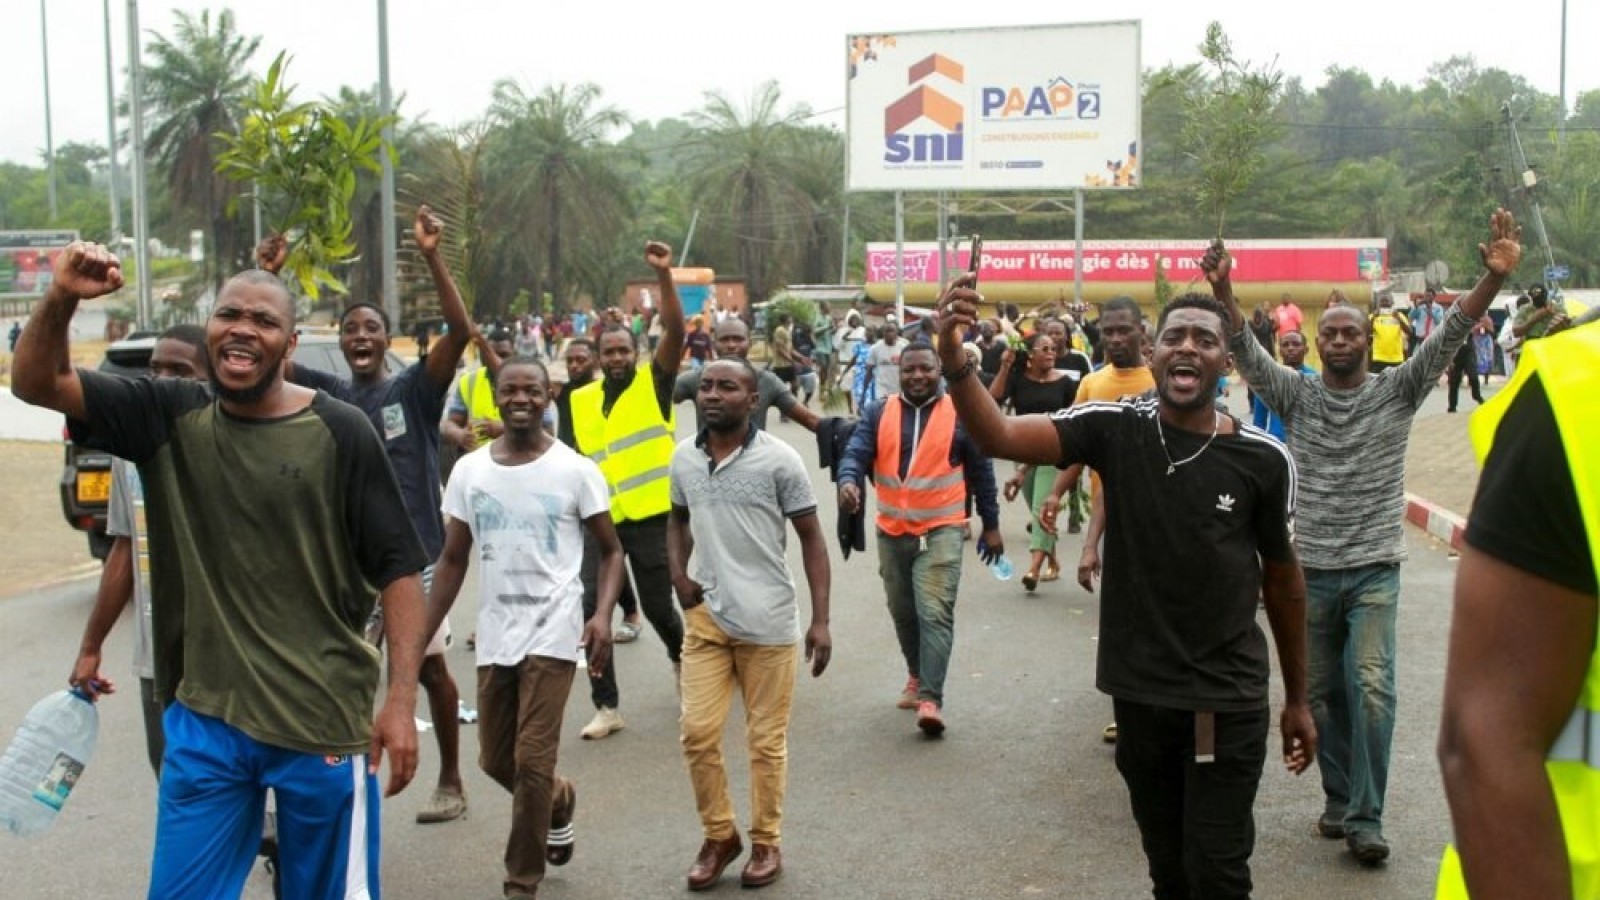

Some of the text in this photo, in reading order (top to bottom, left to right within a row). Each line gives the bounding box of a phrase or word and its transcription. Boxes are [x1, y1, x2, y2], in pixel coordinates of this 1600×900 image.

[982, 85, 1097, 117] PAAP 2
[884, 122, 963, 163] sni
[981, 254, 1024, 270] Pour
[1030, 252, 1110, 273] l'énegie
[1116, 252, 1149, 270] dès
